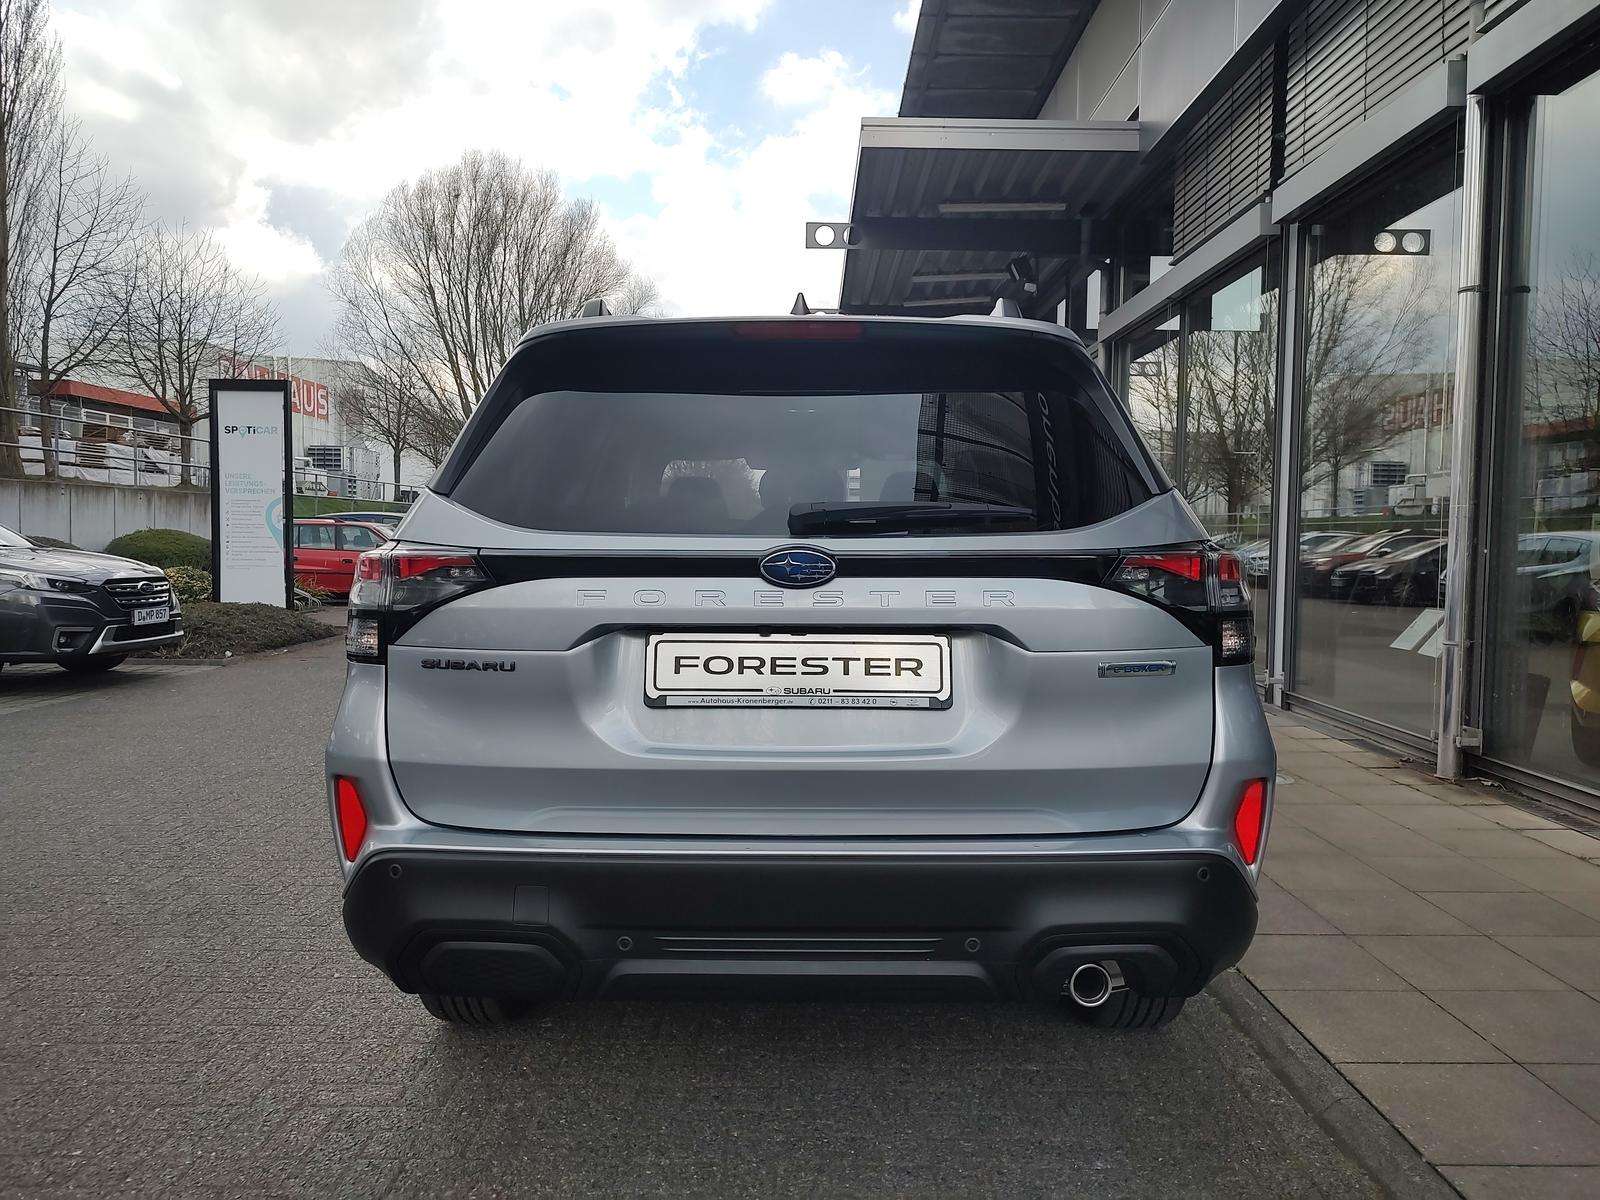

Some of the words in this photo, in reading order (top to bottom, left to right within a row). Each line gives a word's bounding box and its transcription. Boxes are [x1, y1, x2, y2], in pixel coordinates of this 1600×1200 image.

[577, 589, 1016, 607] FORESTER
[155, 609, 167, 619] 857
[421, 659, 516, 672] SUBARU
[673, 655, 923, 677] FORESTER
[783, 687, 831, 695] SUBARU
